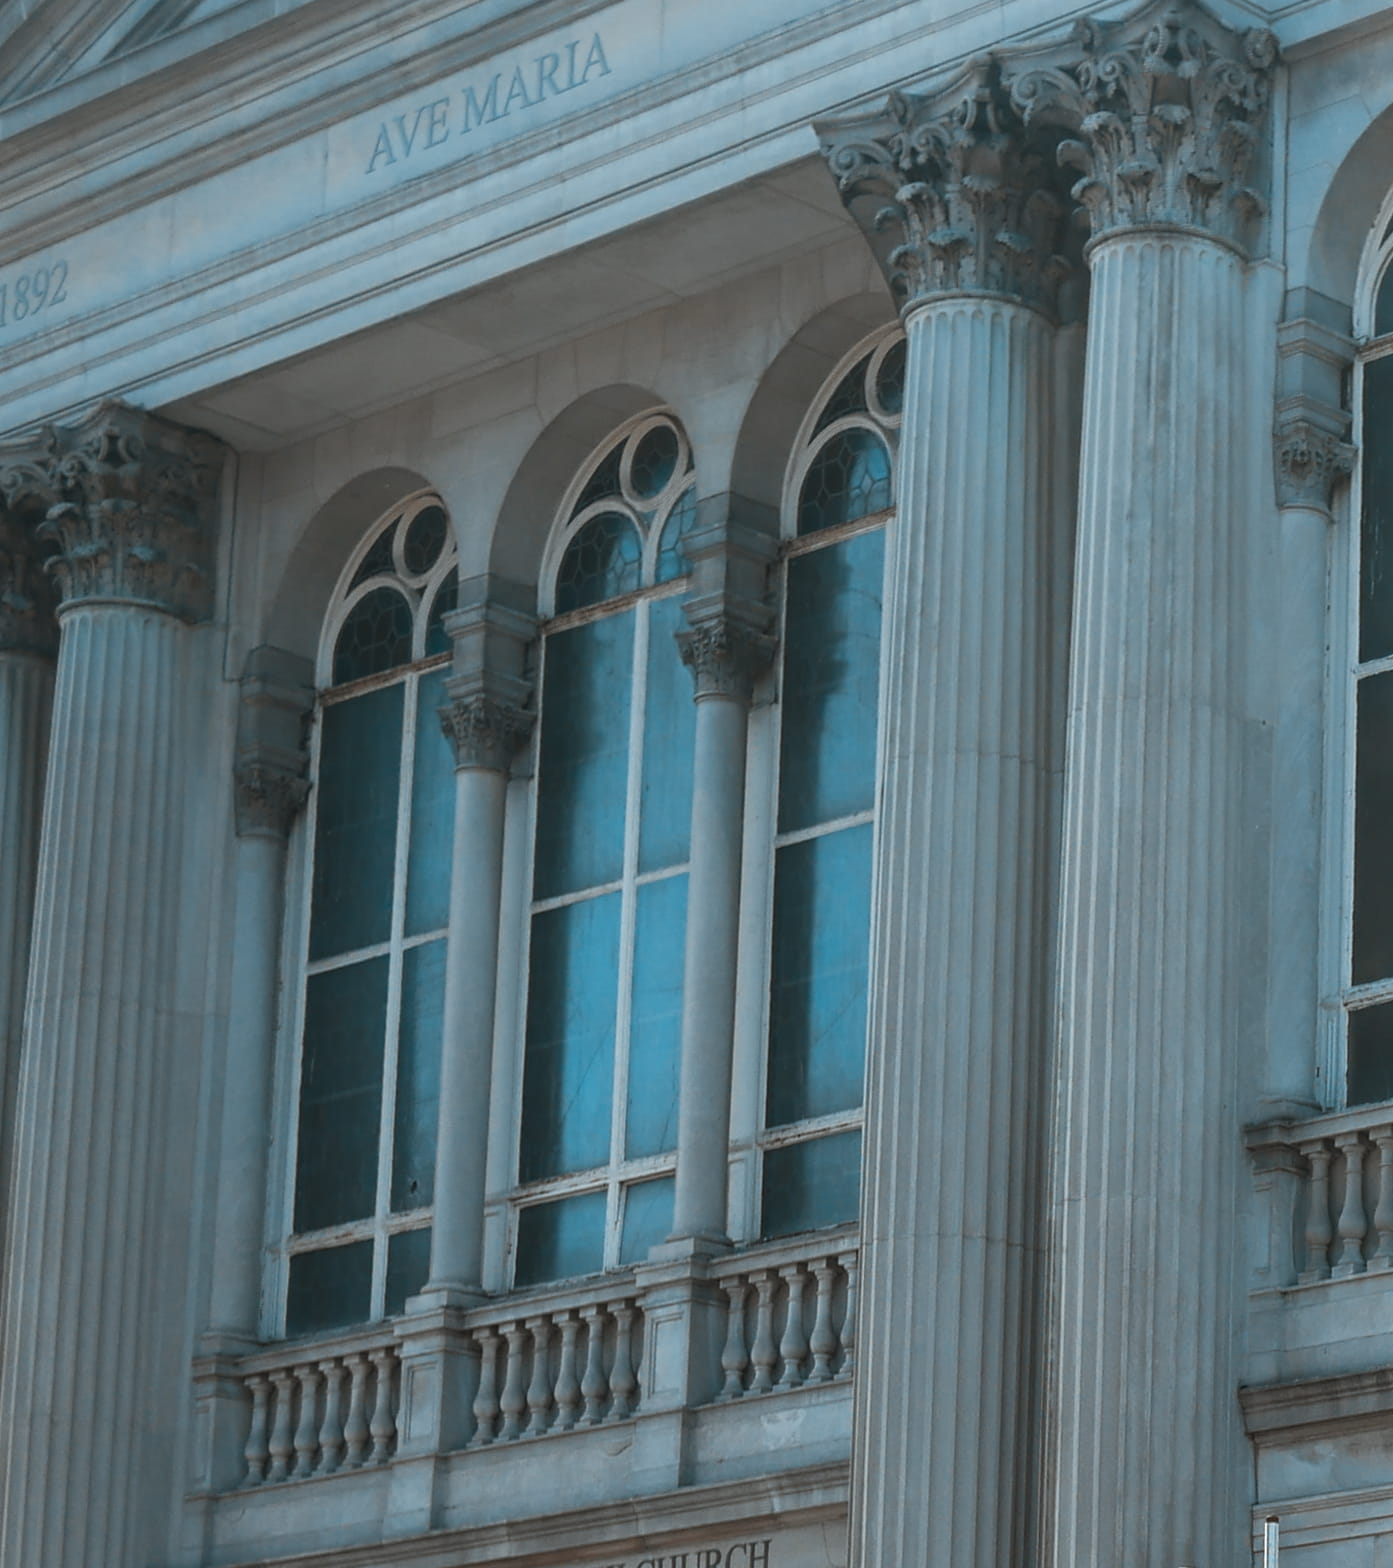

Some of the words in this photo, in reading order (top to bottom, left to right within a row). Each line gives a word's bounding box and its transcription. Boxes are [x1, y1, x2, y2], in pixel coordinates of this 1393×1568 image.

[365, 97, 450, 174] AVE
[460, 32, 611, 135] MARIA
[0, 259, 69, 328] 1892
